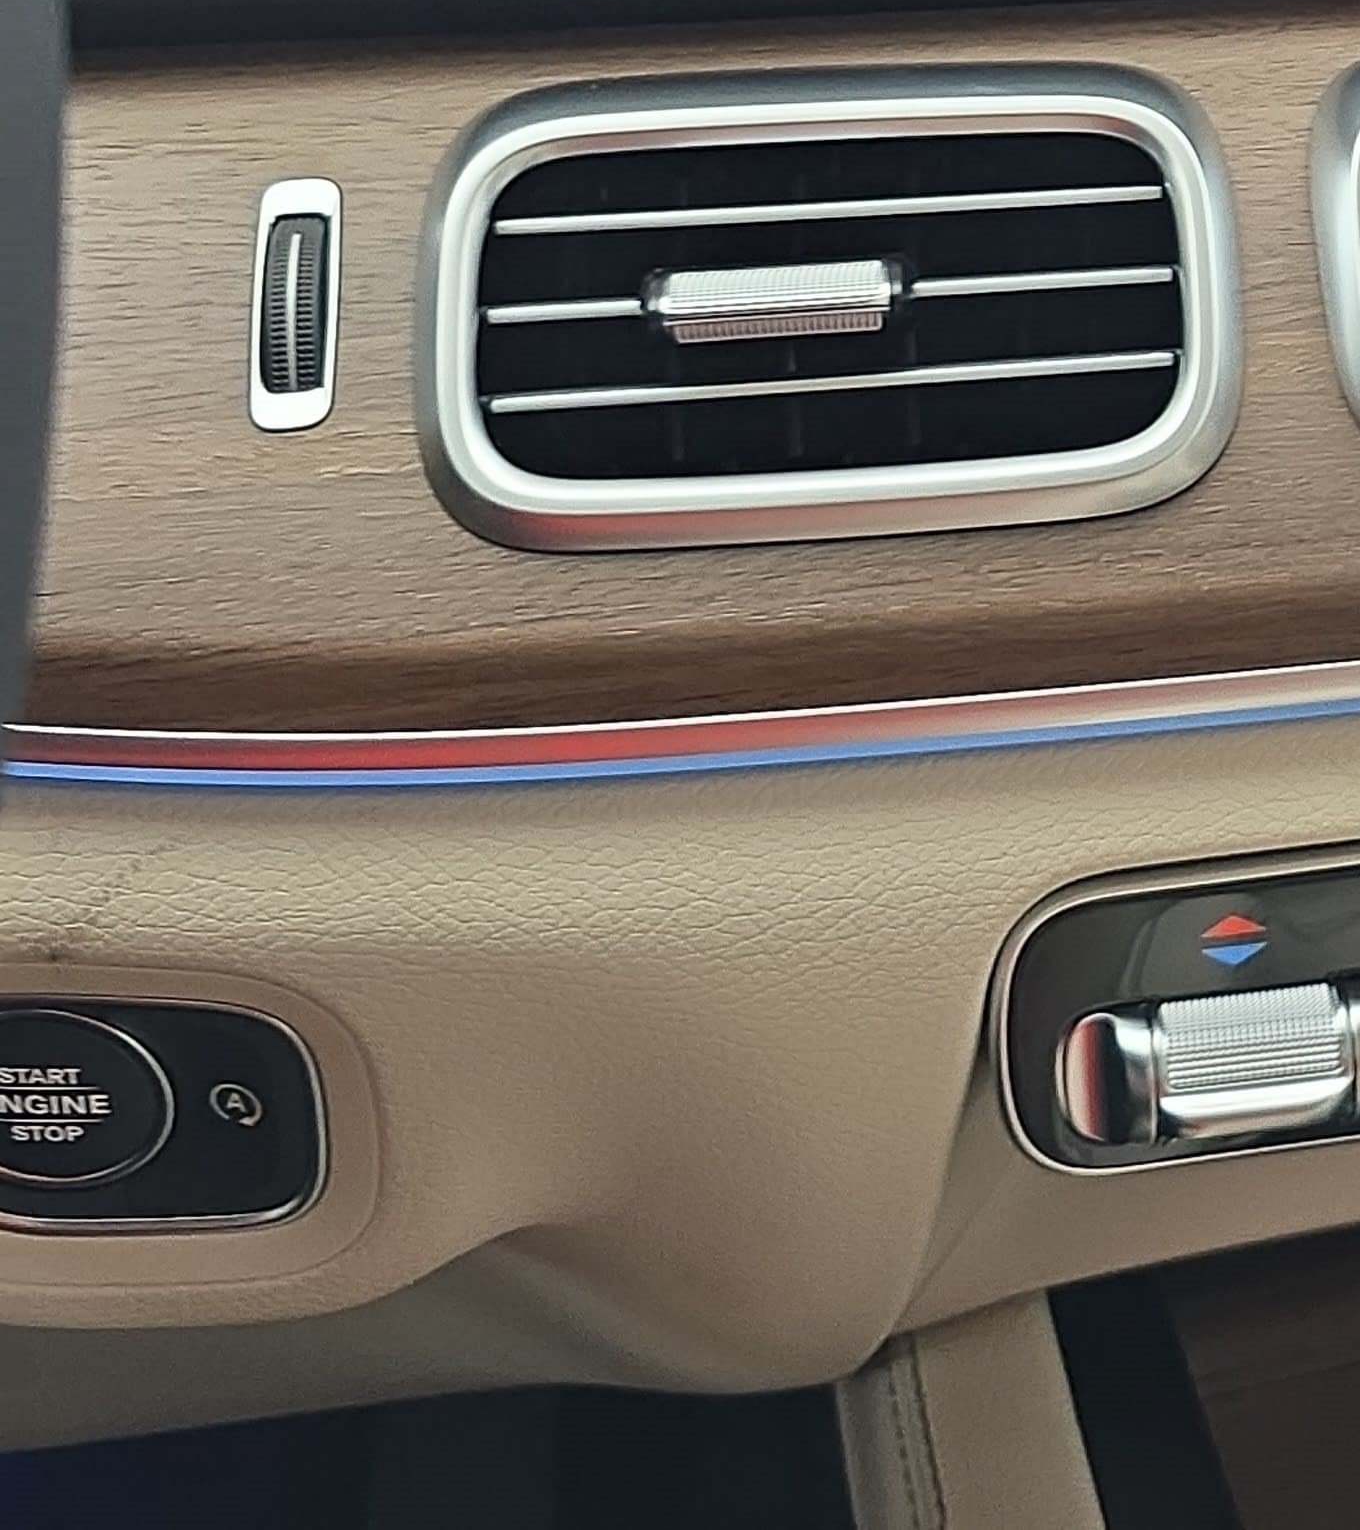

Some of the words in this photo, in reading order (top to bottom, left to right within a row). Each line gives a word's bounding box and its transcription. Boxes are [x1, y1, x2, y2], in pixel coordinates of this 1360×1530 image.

[0, 1067, 82, 1086] START
[0, 1093, 112, 1115] NGINE
[10, 1124, 85, 1143] STOP
